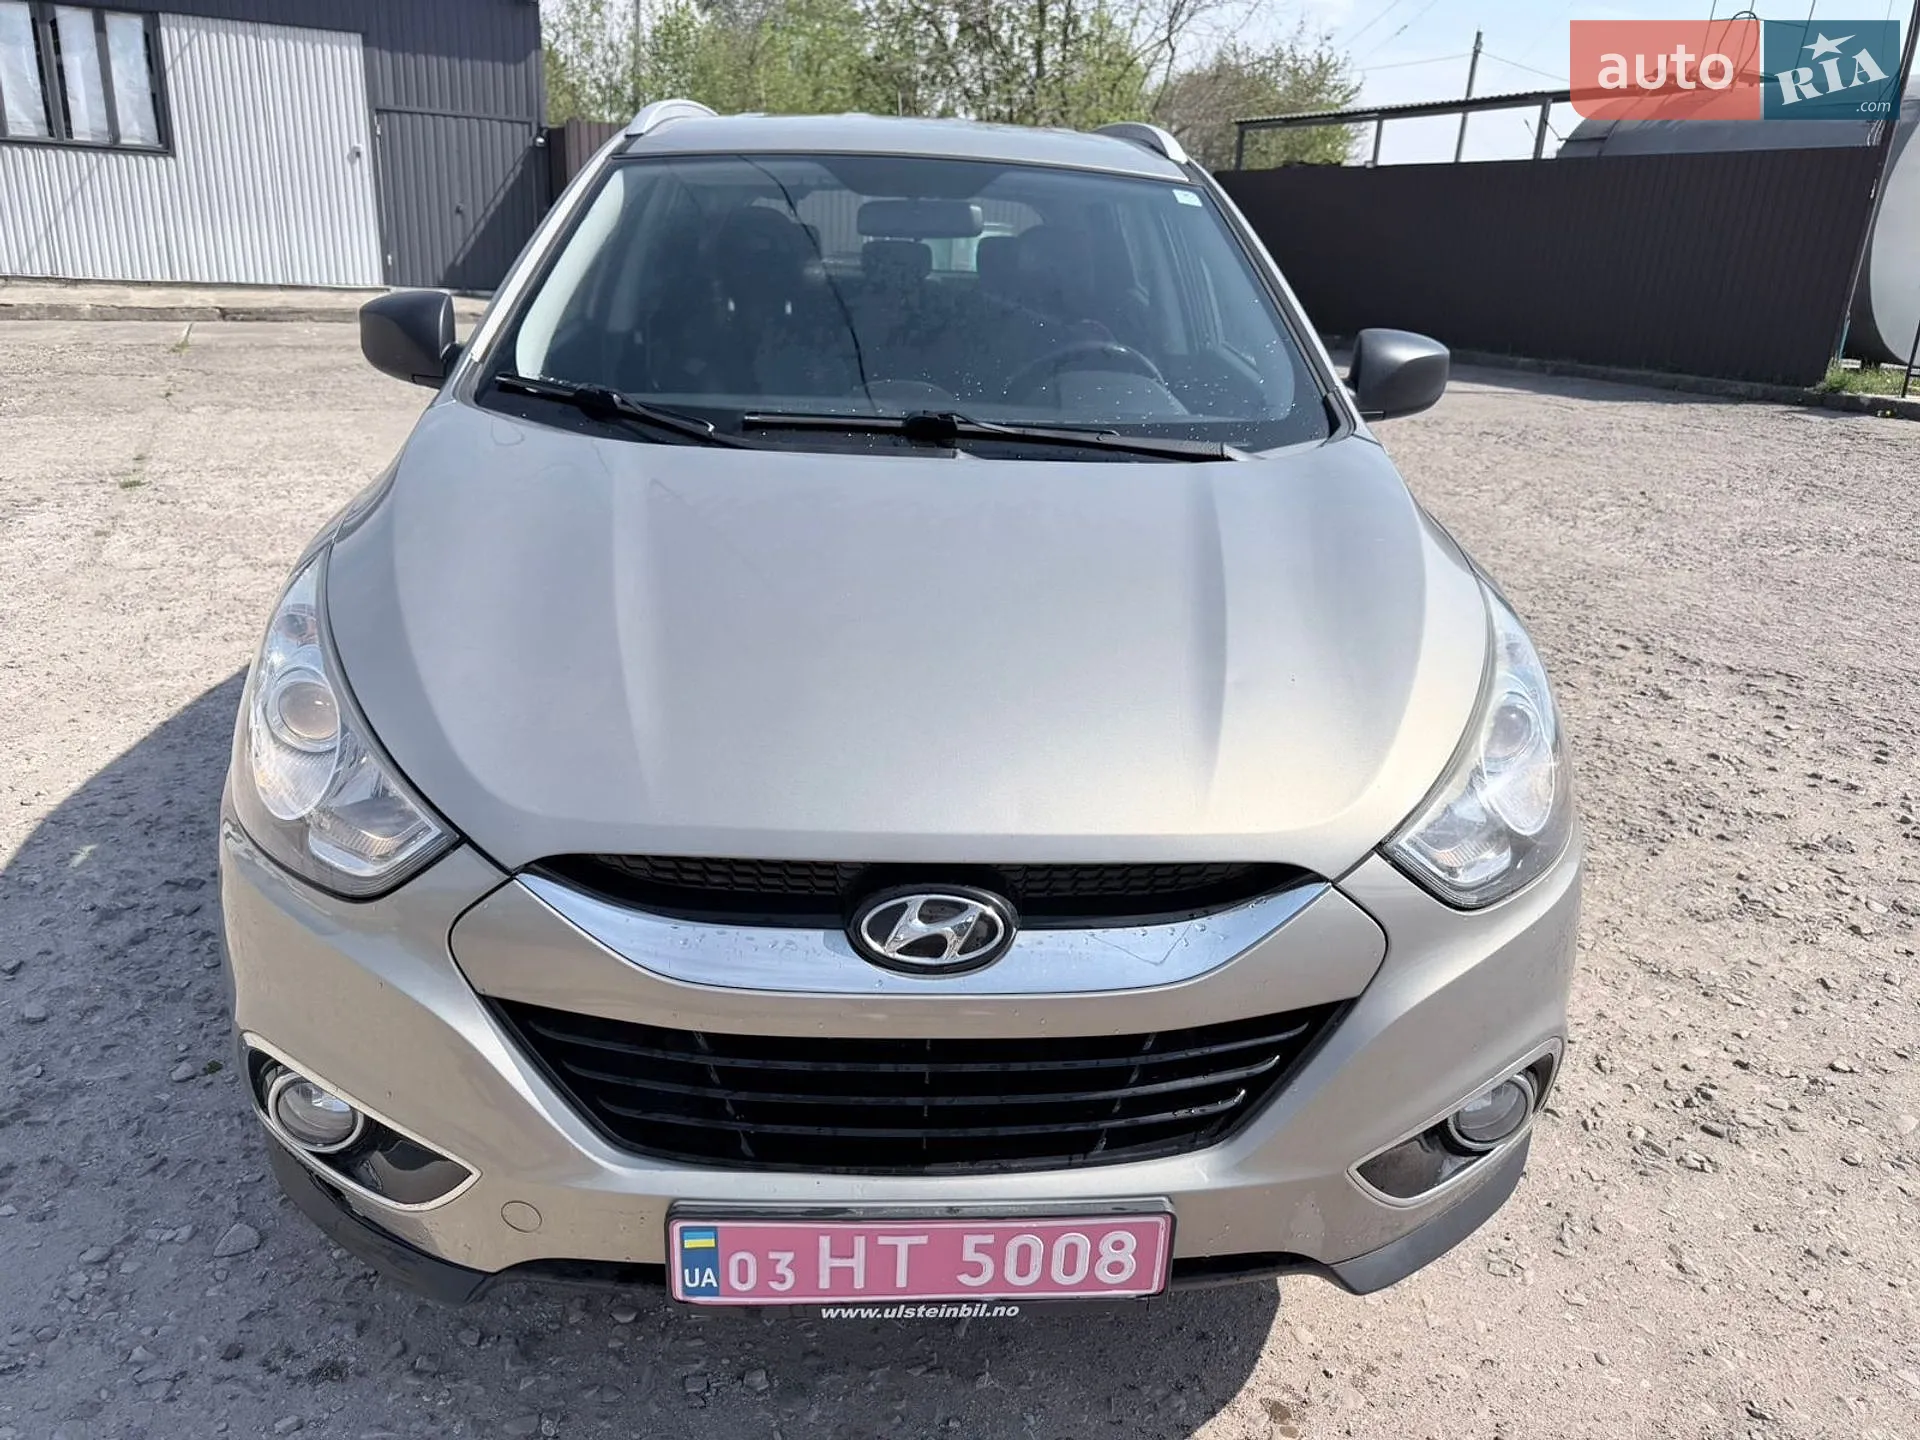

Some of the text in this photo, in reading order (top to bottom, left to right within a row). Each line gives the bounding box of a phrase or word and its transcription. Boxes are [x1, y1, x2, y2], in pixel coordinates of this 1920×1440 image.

[728, 1230, 1137, 1291] 03 HT 5008
[684, 1267, 718, 1288] UA
[820, 1303, 1020, 1319] www.ulsteinbil.no
